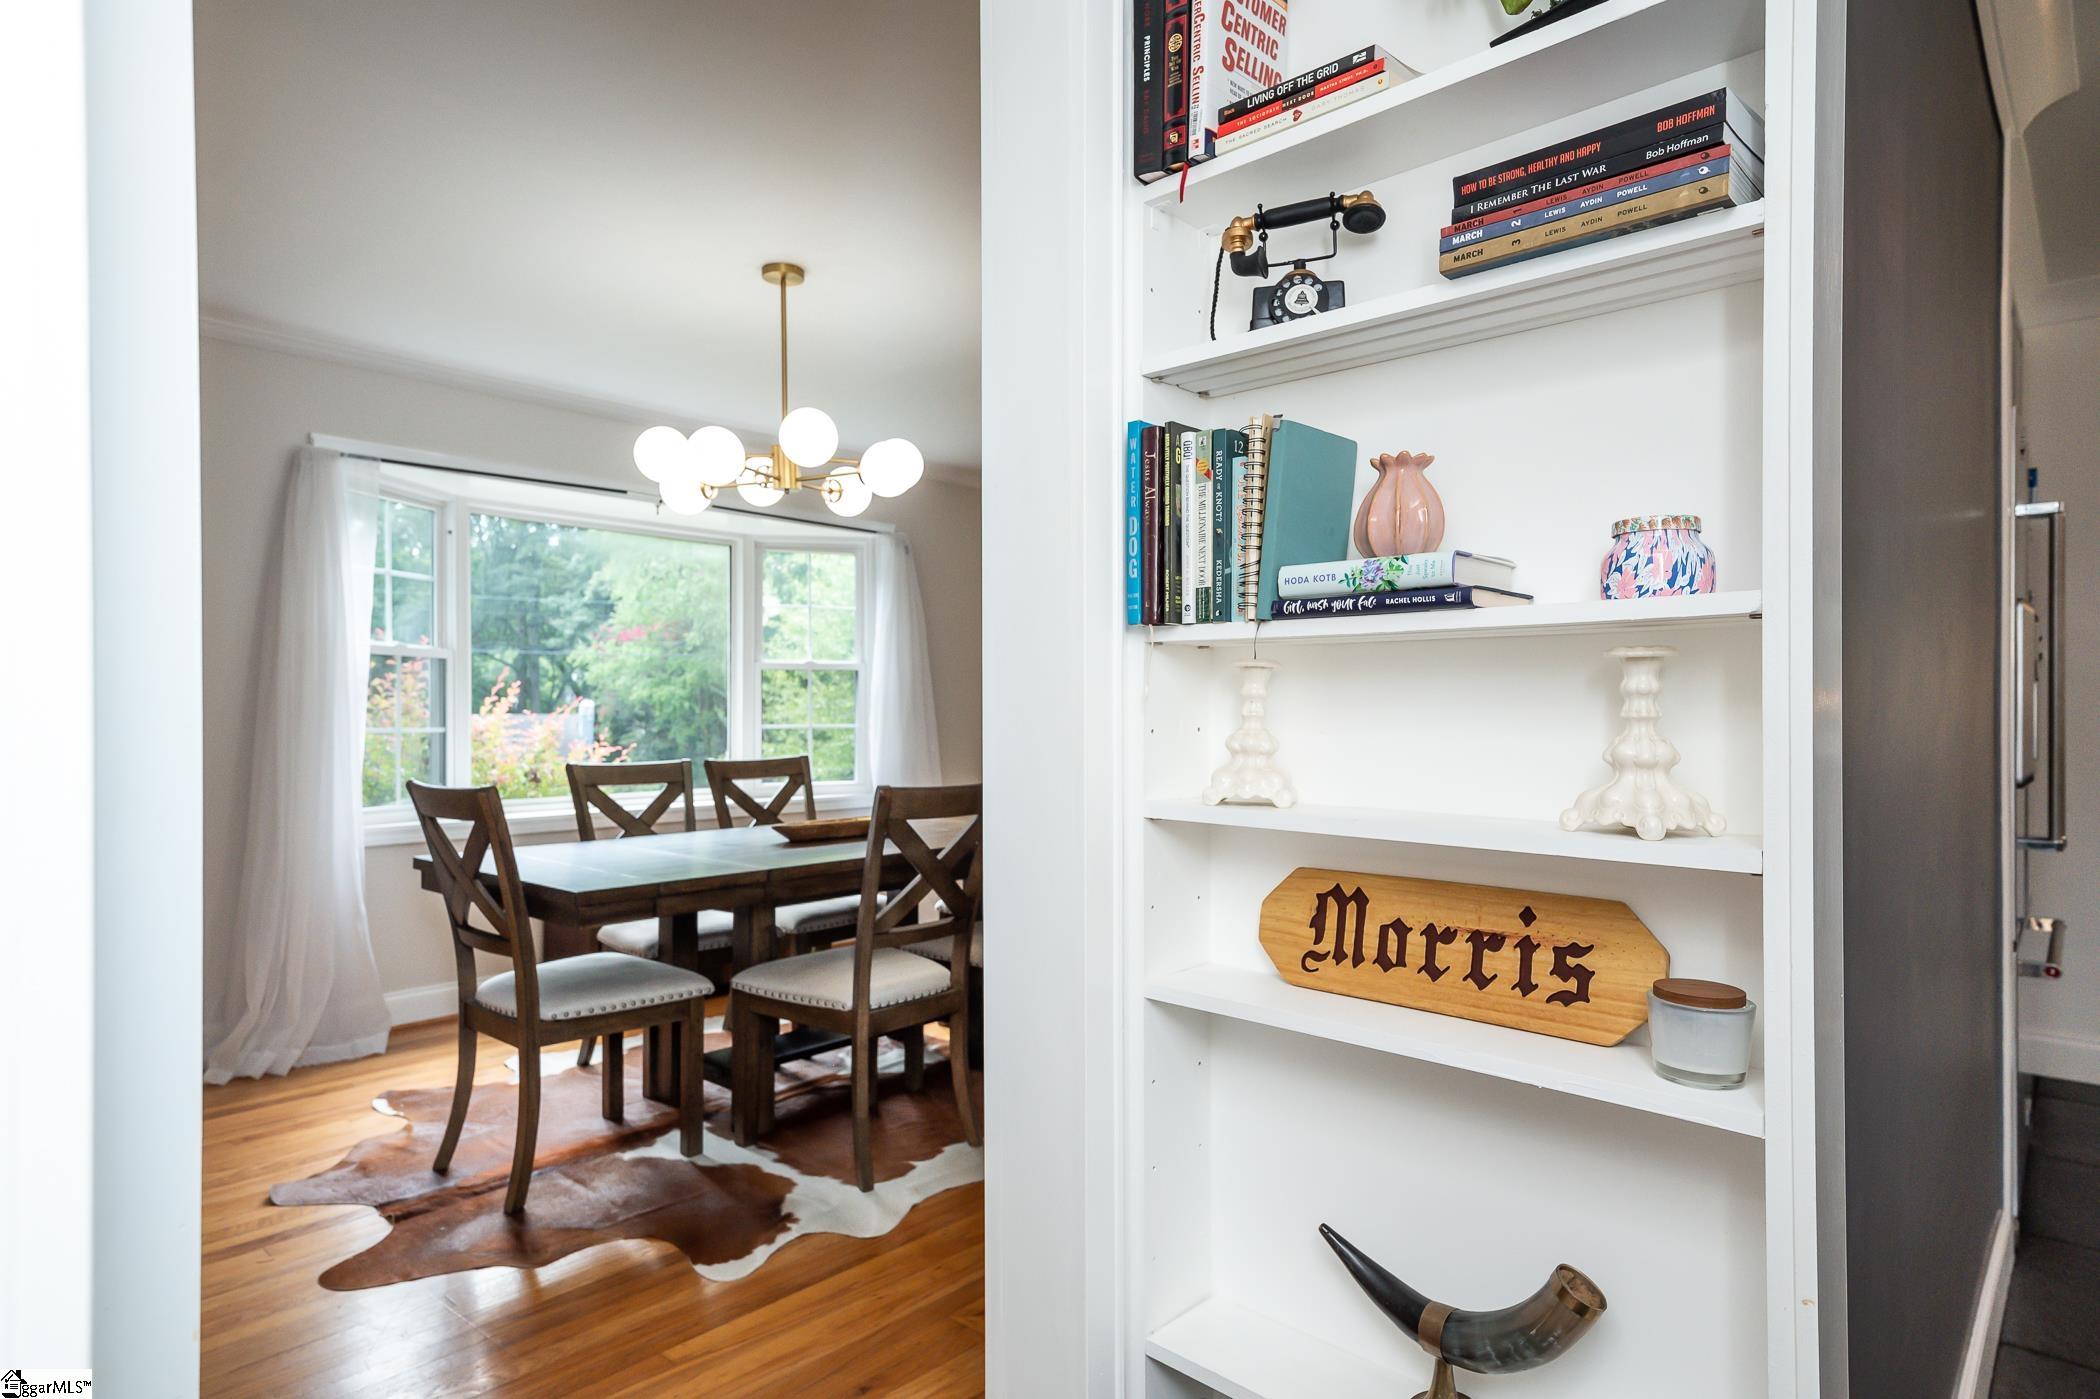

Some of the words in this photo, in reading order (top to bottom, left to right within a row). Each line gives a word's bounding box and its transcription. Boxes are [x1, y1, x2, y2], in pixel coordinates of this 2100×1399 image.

[1221, 1, 1279, 61] CENTRIC
[1143, 35, 1151, 82] PRINCIPLES
[1247, 90, 1275, 108] LIVING
[1276, 81, 1294, 96] OFF
[1296, 72, 1315, 88] THE
[1316, 62, 1339, 79] GRID
[1657, 118, 1674, 133] BOB
[1676, 105, 1715, 126] HOFFMAN
[1461, 182, 1477, 196] HOW
[1478, 179, 1487, 190] TO
[1488, 175, 1497, 186] BE
[1498, 166, 1527, 184] STRONG,
[1528, 157, 1559, 174] HEALTHY
[1559, 150, 1575, 164] AND
[1576, 142, 1601, 159] HAPPY
[1646, 147, 1665, 160] Bob
[1666, 134, 1709, 153] Hoffman
[1454, 218, 1484, 232] MARCH
[1545, 194, 1568, 205] LEWIS
[1582, 183, 1604, 195] AYDIN
[1618, 170, 1649, 184] POWELL
[1470, 205, 1474, 214] I
[1477, 189, 1529, 212] REMEMBER
[1531, 181, 1552, 194] THE
[1555, 173, 1580, 187] LAST
[1582, 164, 1607, 178] WAR
[1452, 230, 1483, 245] MARCH
[1511, 219, 1522, 228] 2
[1544, 207, 1566, 218] LEWIS
[1580, 197, 1603, 208] AYDIN
[1616, 185, 1648, 198] POWELL
[1453, 248, 1484, 263] MARCH
[1545, 226, 1567, 237] LEWIS
[1580, 216, 1603, 228] AYDIN
[1617, 204, 1648, 217] POWELL
[1129, 438, 1137, 507] WATER
[1144, 451, 1156, 480] Jesus
[1215, 450, 1223, 480] READY
[1198, 484, 1207, 497] THE
[1215, 492, 1223, 522] KNOT?
[1198, 500, 1207, 543] MILLIONAIRE
[1128, 516, 1138, 578] DOG
[1198, 545, 1207, 564] NEXT
[1215, 559, 1223, 604] KEDERSHA
[1284, 576, 1310, 586] HODA
[1313, 573, 1337, 583] KOTB
[1385, 596, 1411, 605] RACHEL
[1412, 595, 1436, 603] HOLLIS
[1301, 883, 1596, 1007] Morris
